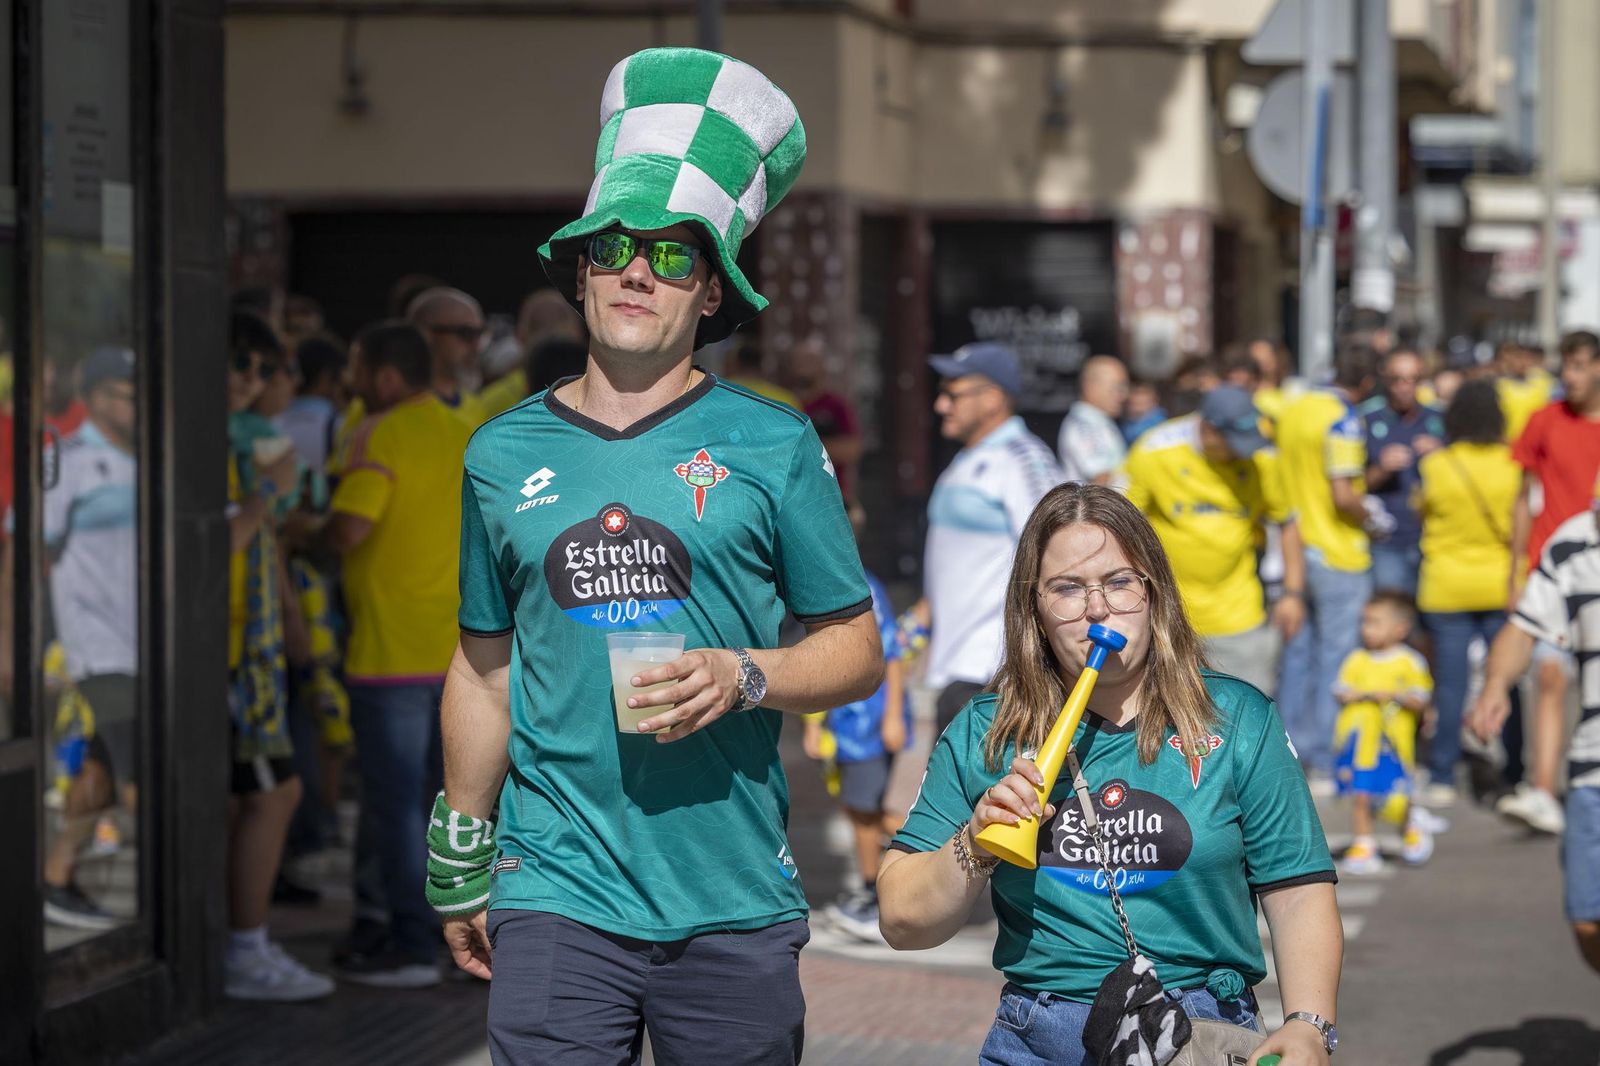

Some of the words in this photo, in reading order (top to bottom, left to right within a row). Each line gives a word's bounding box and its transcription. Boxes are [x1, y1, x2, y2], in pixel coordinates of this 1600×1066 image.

[515, 495, 559, 513] LOTTO
[565, 539, 667, 570] Estrella
[571, 567, 669, 599] Galicia
[608, 597, 640, 623] 0,0
